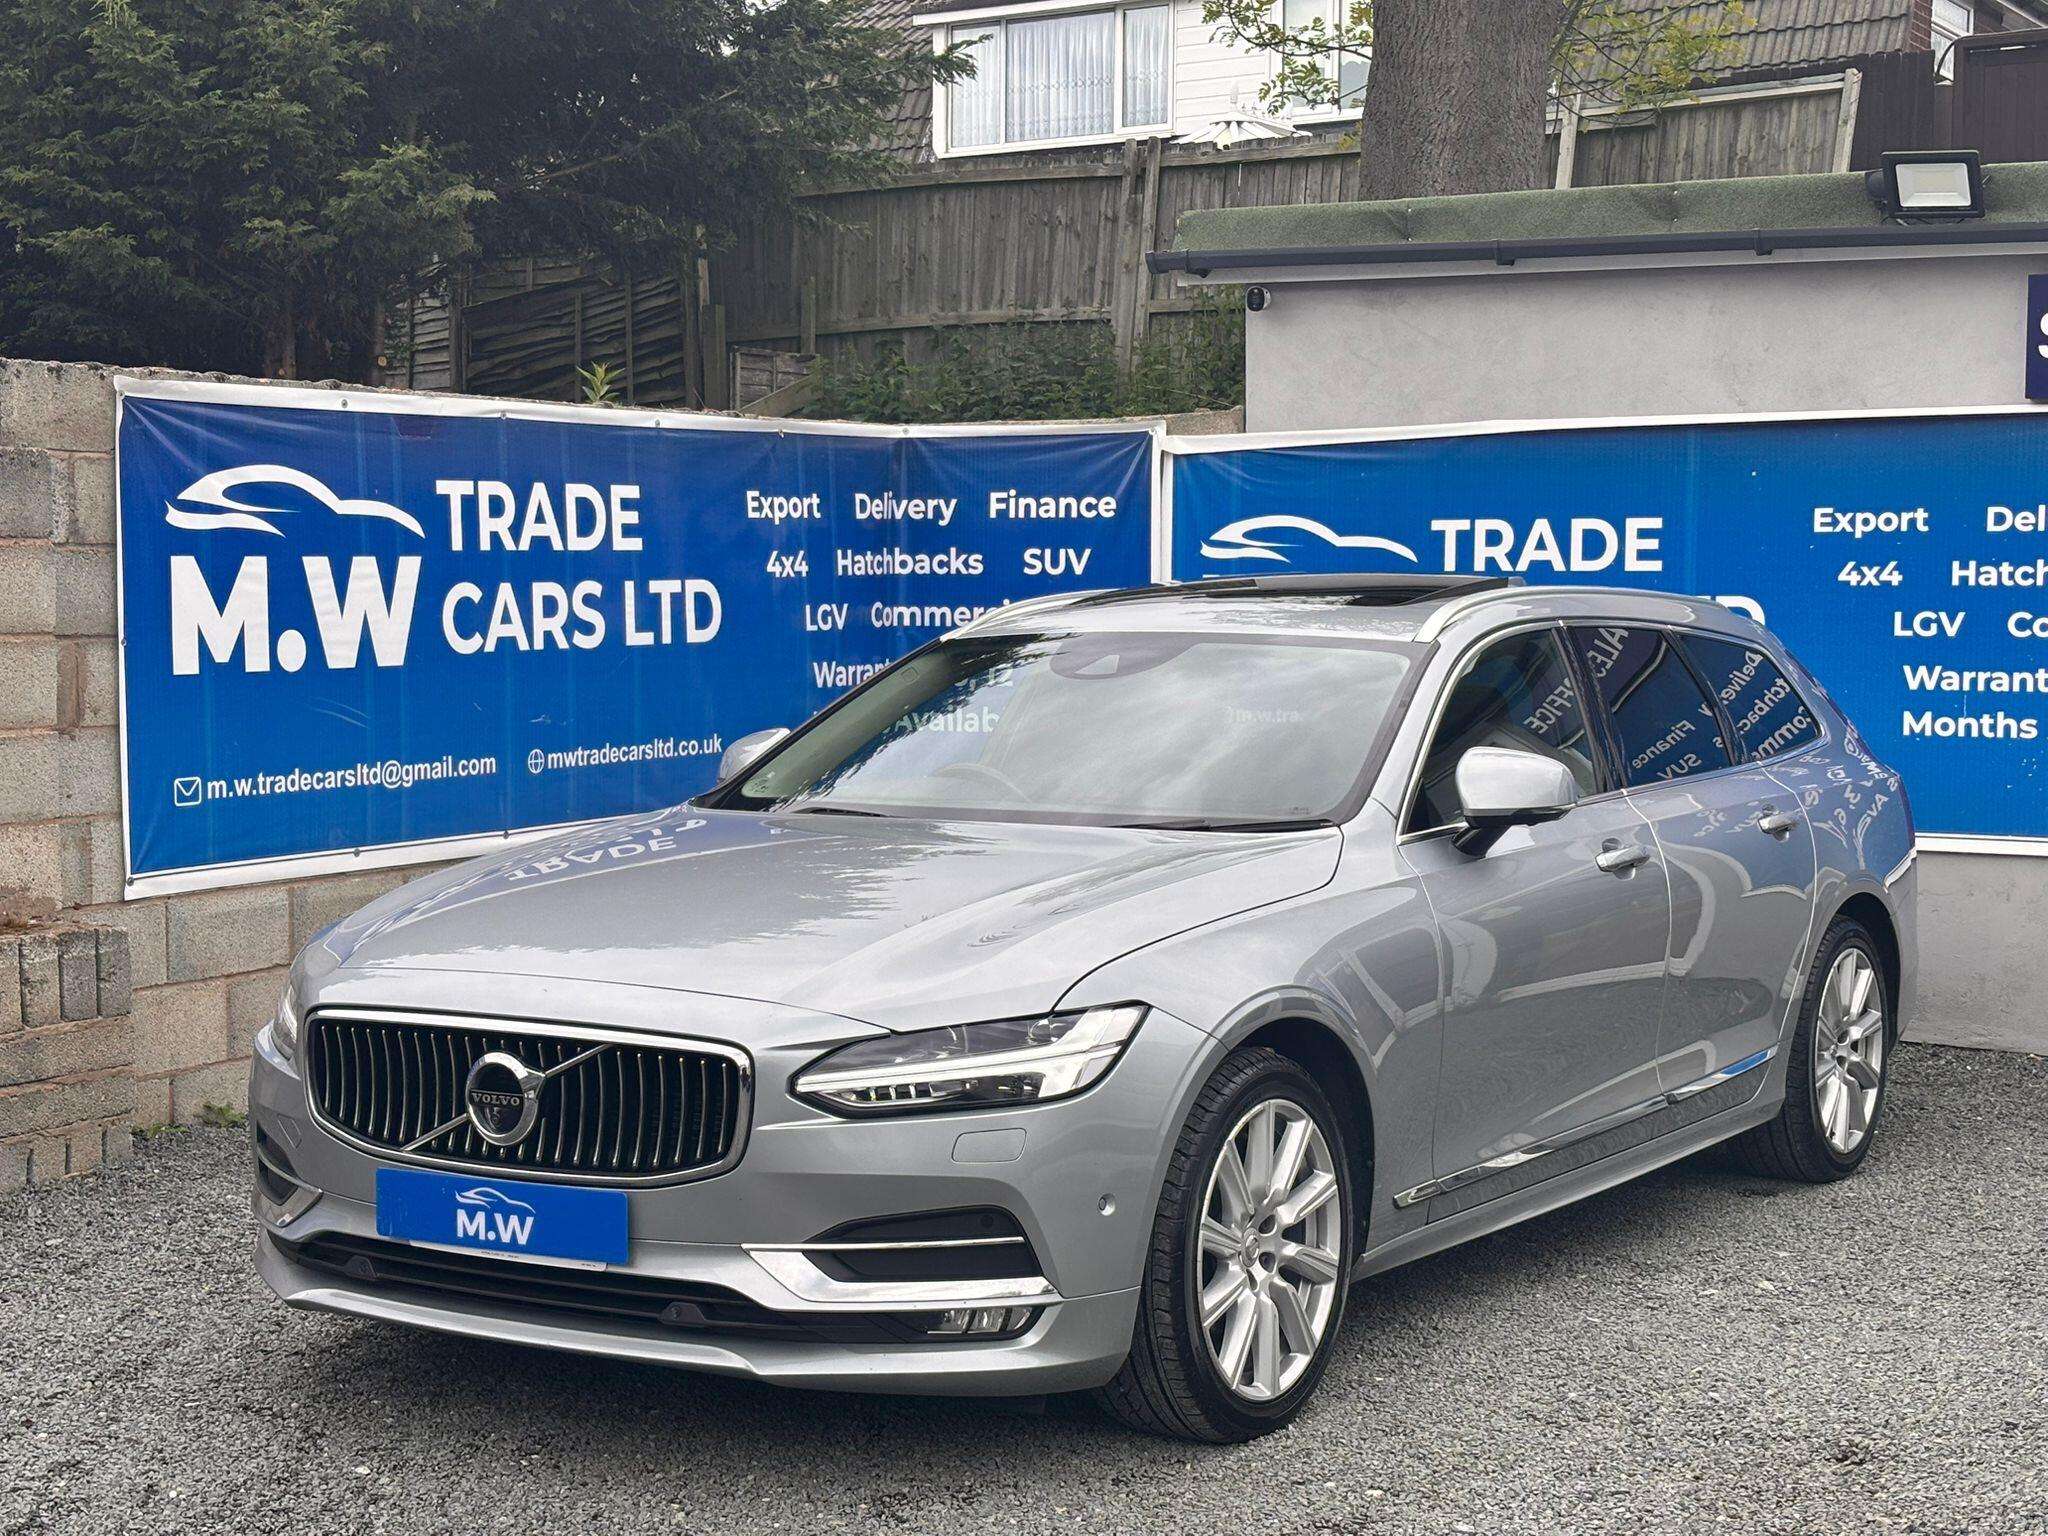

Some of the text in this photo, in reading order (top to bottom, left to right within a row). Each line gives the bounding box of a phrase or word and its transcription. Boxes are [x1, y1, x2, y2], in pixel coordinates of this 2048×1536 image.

[436, 480, 643, 551] TRADE
[746, 488, 1118, 526] Export Delivery Finance
[1813, 505, 2046, 539] Export Del
[766, 547, 1092, 577] 4x4 Hatchbacks SUV
[1431, 518, 1663, 572] TRADE
[1837, 560, 1903, 586] 4x4
[170, 555, 423, 675] M.W
[442, 579, 722, 655] CARS LTD
[806, 598, 1010, 632] LGV Commer
[1893, 611, 1966, 637] LGV
[1902, 664, 2048, 693] Warrant
[1902, 711, 2039, 739] Months
[207, 733, 722, 799] m.w.tradecarsltd@gmail.com mwtradecarsltd.co.uk
[471, 1092, 520, 1106] VOLVO
[456, 1208, 535, 1246] M.W
